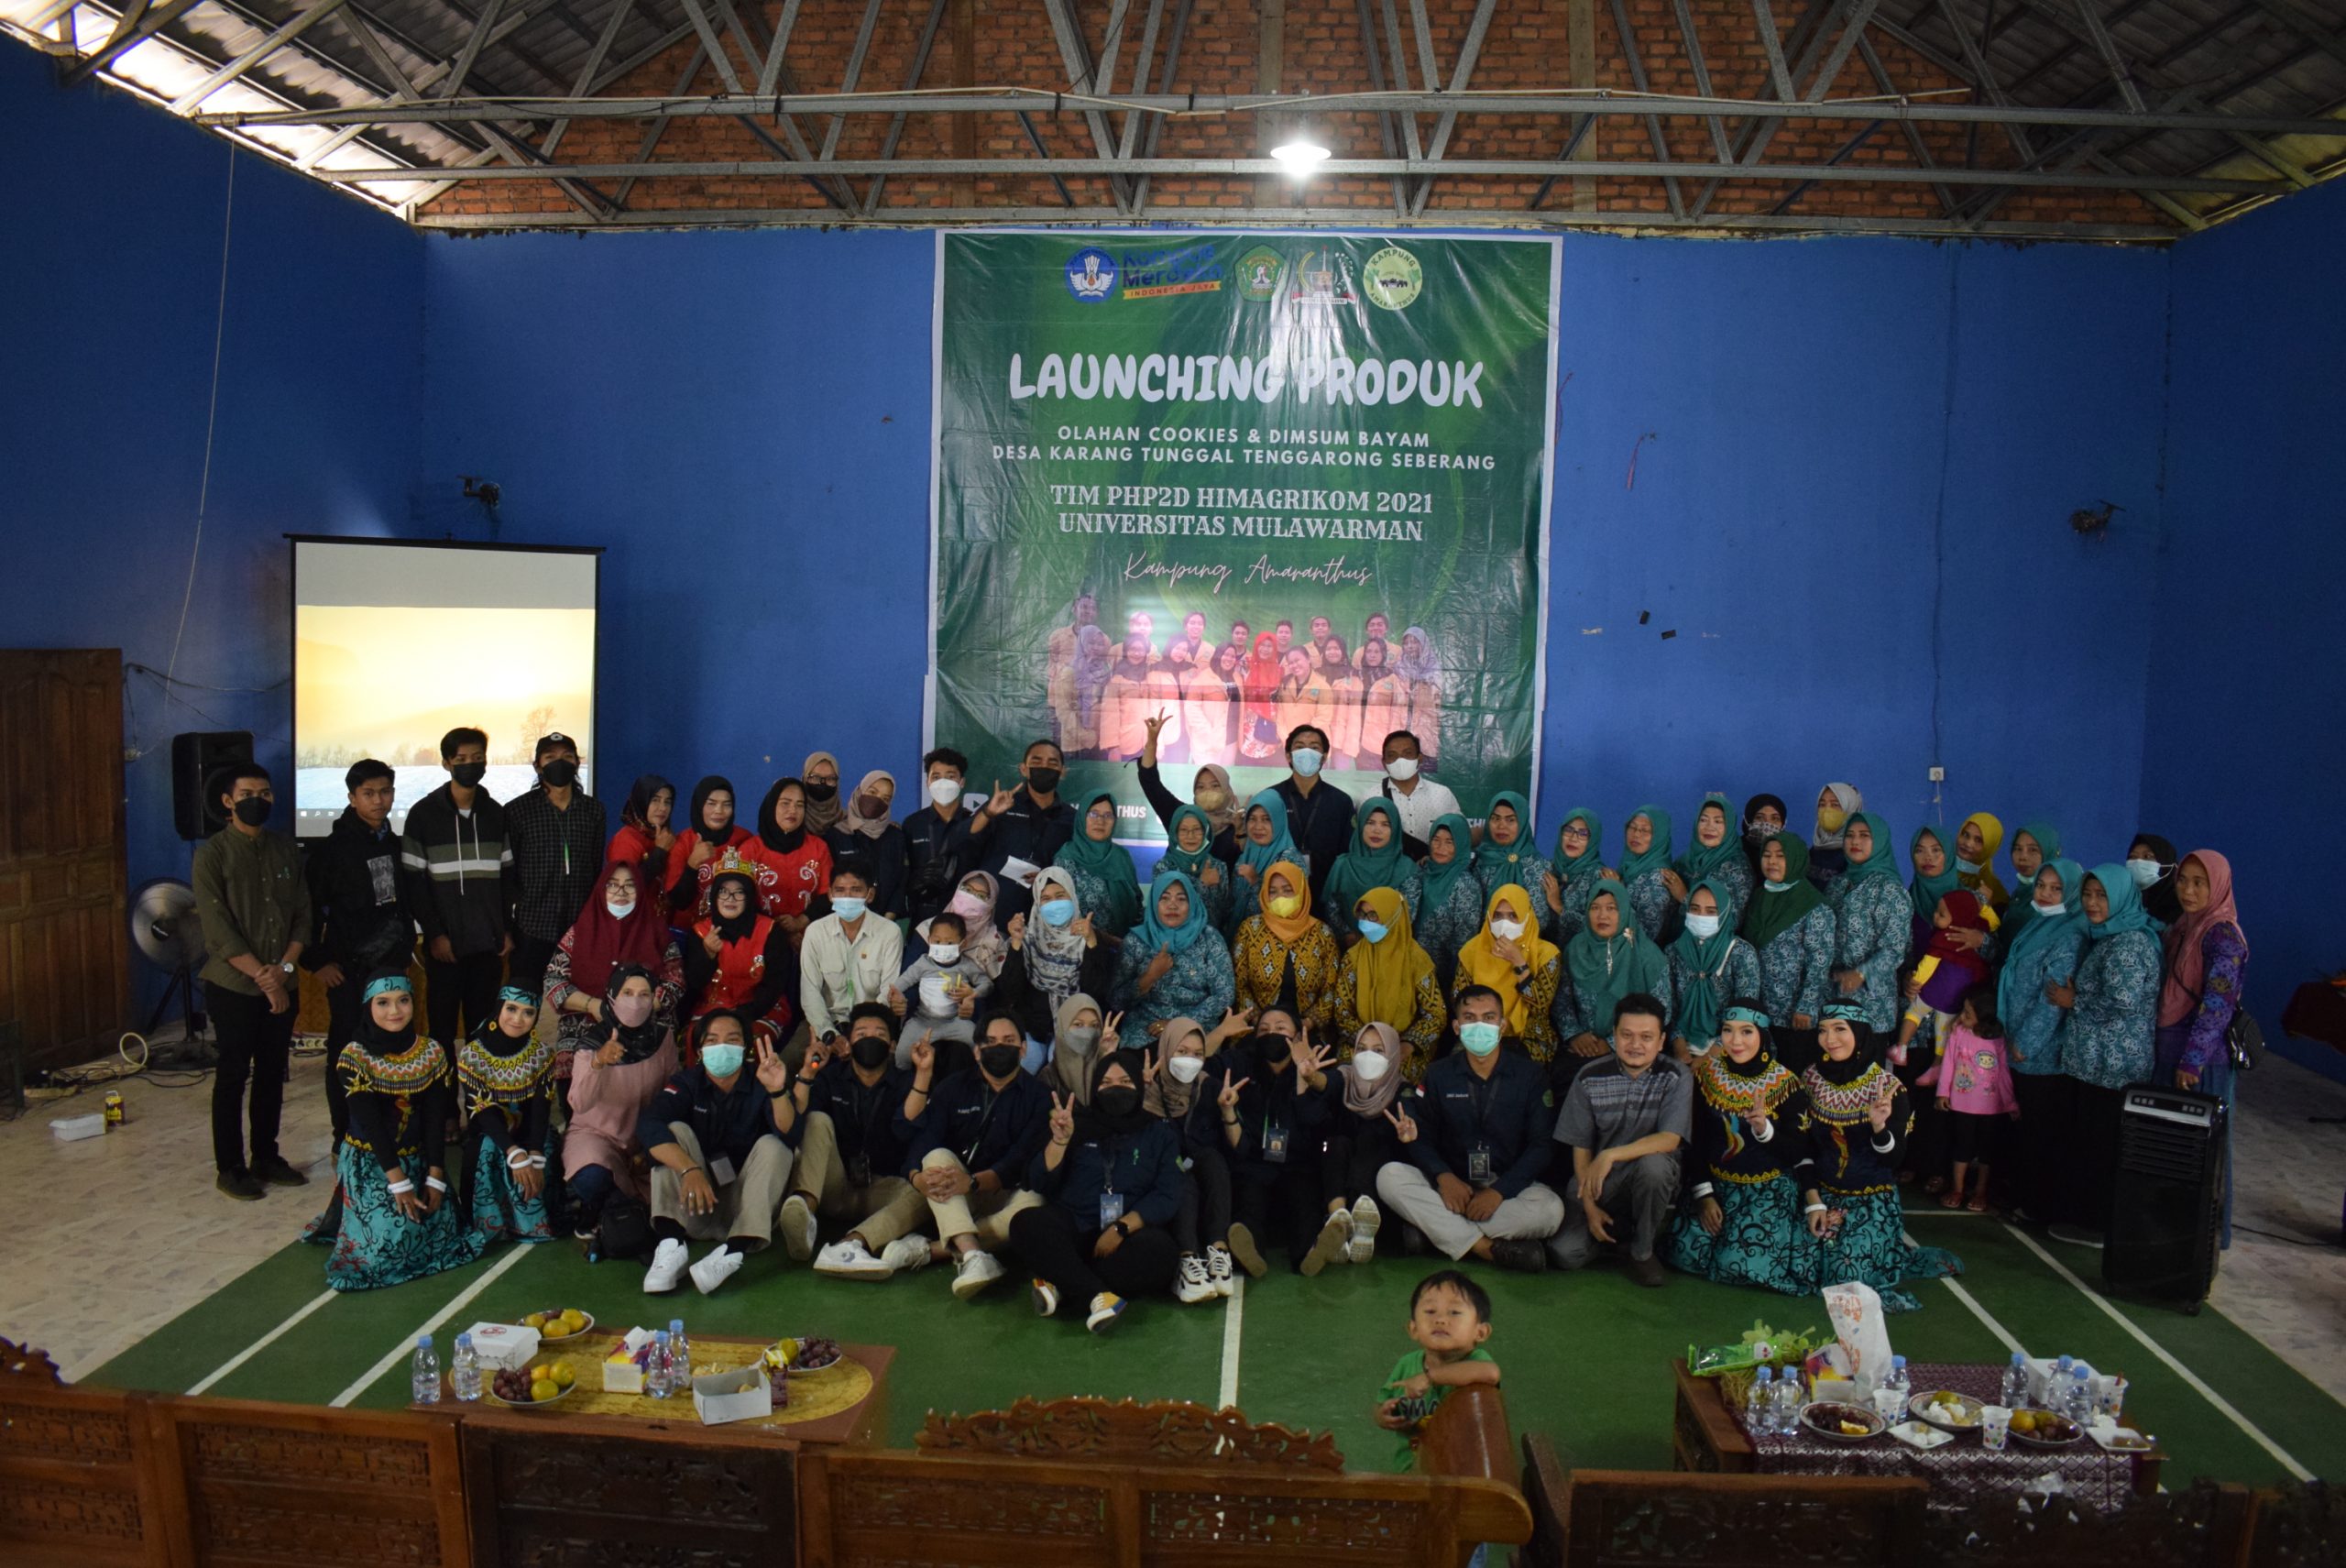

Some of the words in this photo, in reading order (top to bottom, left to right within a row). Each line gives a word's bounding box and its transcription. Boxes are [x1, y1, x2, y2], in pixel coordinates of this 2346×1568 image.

[1372, 248, 1416, 267] KAMPUNG
[1009, 353, 1286, 404] LAUNCHING
[1298, 356, 1484, 409] PRODUK
[1058, 425, 1140, 441] OLAHAN
[1148, 427, 1238, 443] COOKIES
[1247, 429, 1261, 444] &
[1269, 430, 1349, 445] DIMSUM
[1358, 432, 1429, 447] BAYAM
[992, 445, 1041, 459] DESA
[1050, 445, 1133, 461] KARANG
[1141, 447, 1233, 463] TUNGGAL
[1244, 449, 1383, 466] TENGGARONG
[1391, 453, 1496, 470] SEBERANG
[1050, 484, 1100, 505] TIM
[1106, 486, 1190, 508] PHP2D
[1196, 487, 1370, 511] HIMAGRIKOM
[1376, 491, 1432, 513] 2021
[1058, 512, 1225, 536] UNIVERSITAS
[1231, 516, 1423, 541] MULAWARMAN
[1124, 551, 1233, 594] Kampung
[1244, 554, 1373, 587] Amaranthus
